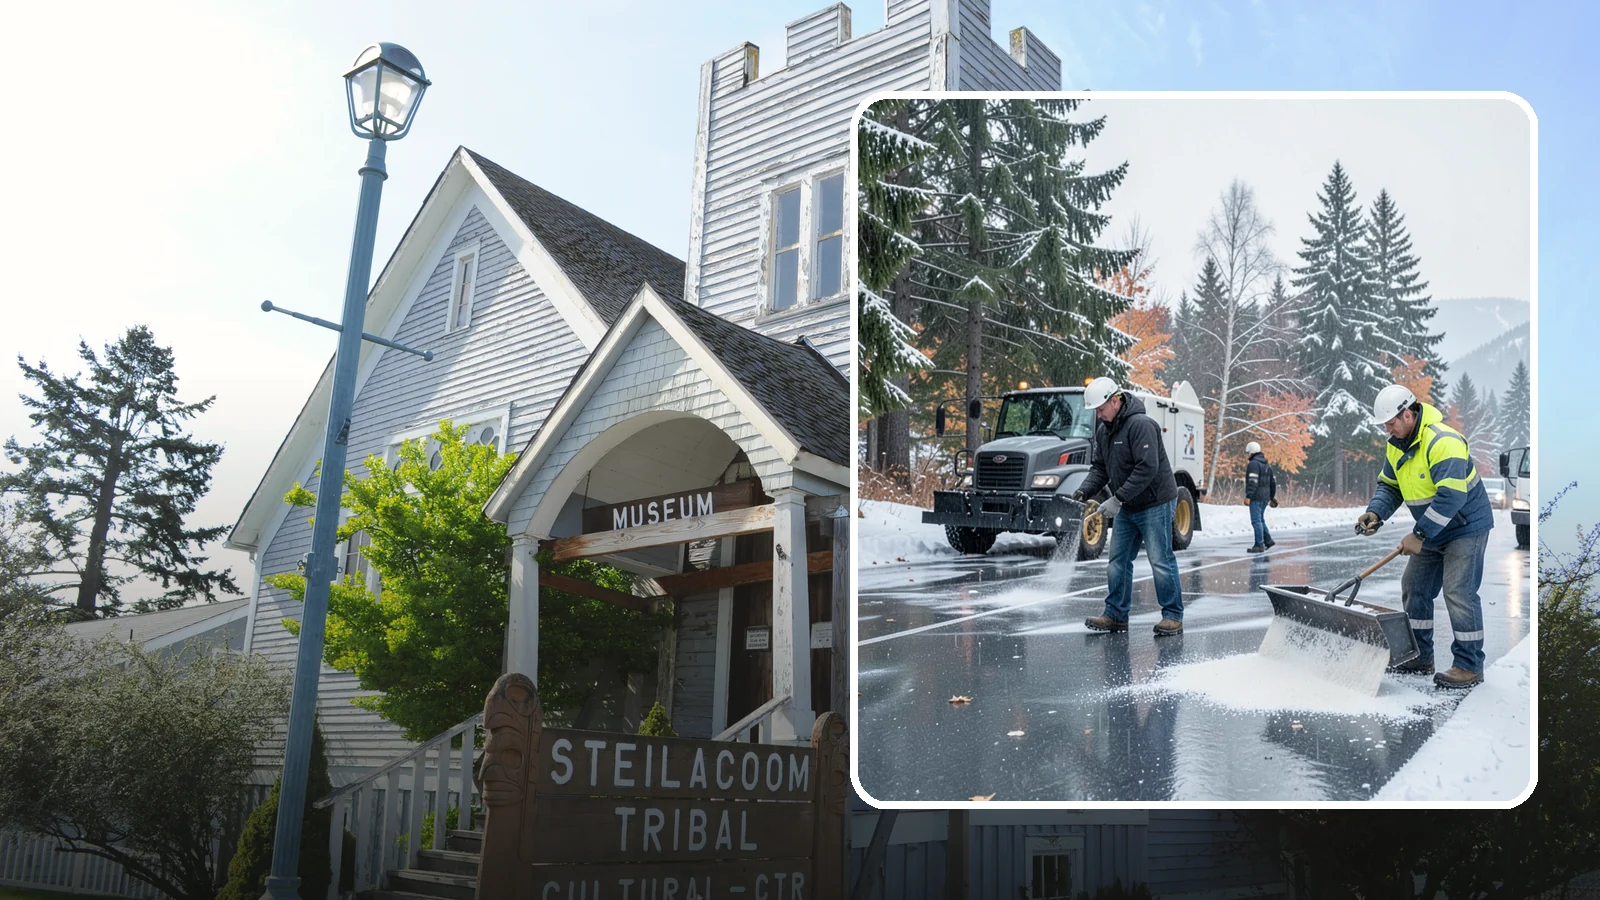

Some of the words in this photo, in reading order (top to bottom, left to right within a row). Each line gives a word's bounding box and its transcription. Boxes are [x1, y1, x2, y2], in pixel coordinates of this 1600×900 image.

[612, 491, 714, 530] MUSEUM
[551, 738, 809, 792] STEILACOOM
[615, 807, 758, 852] TRIBAL
